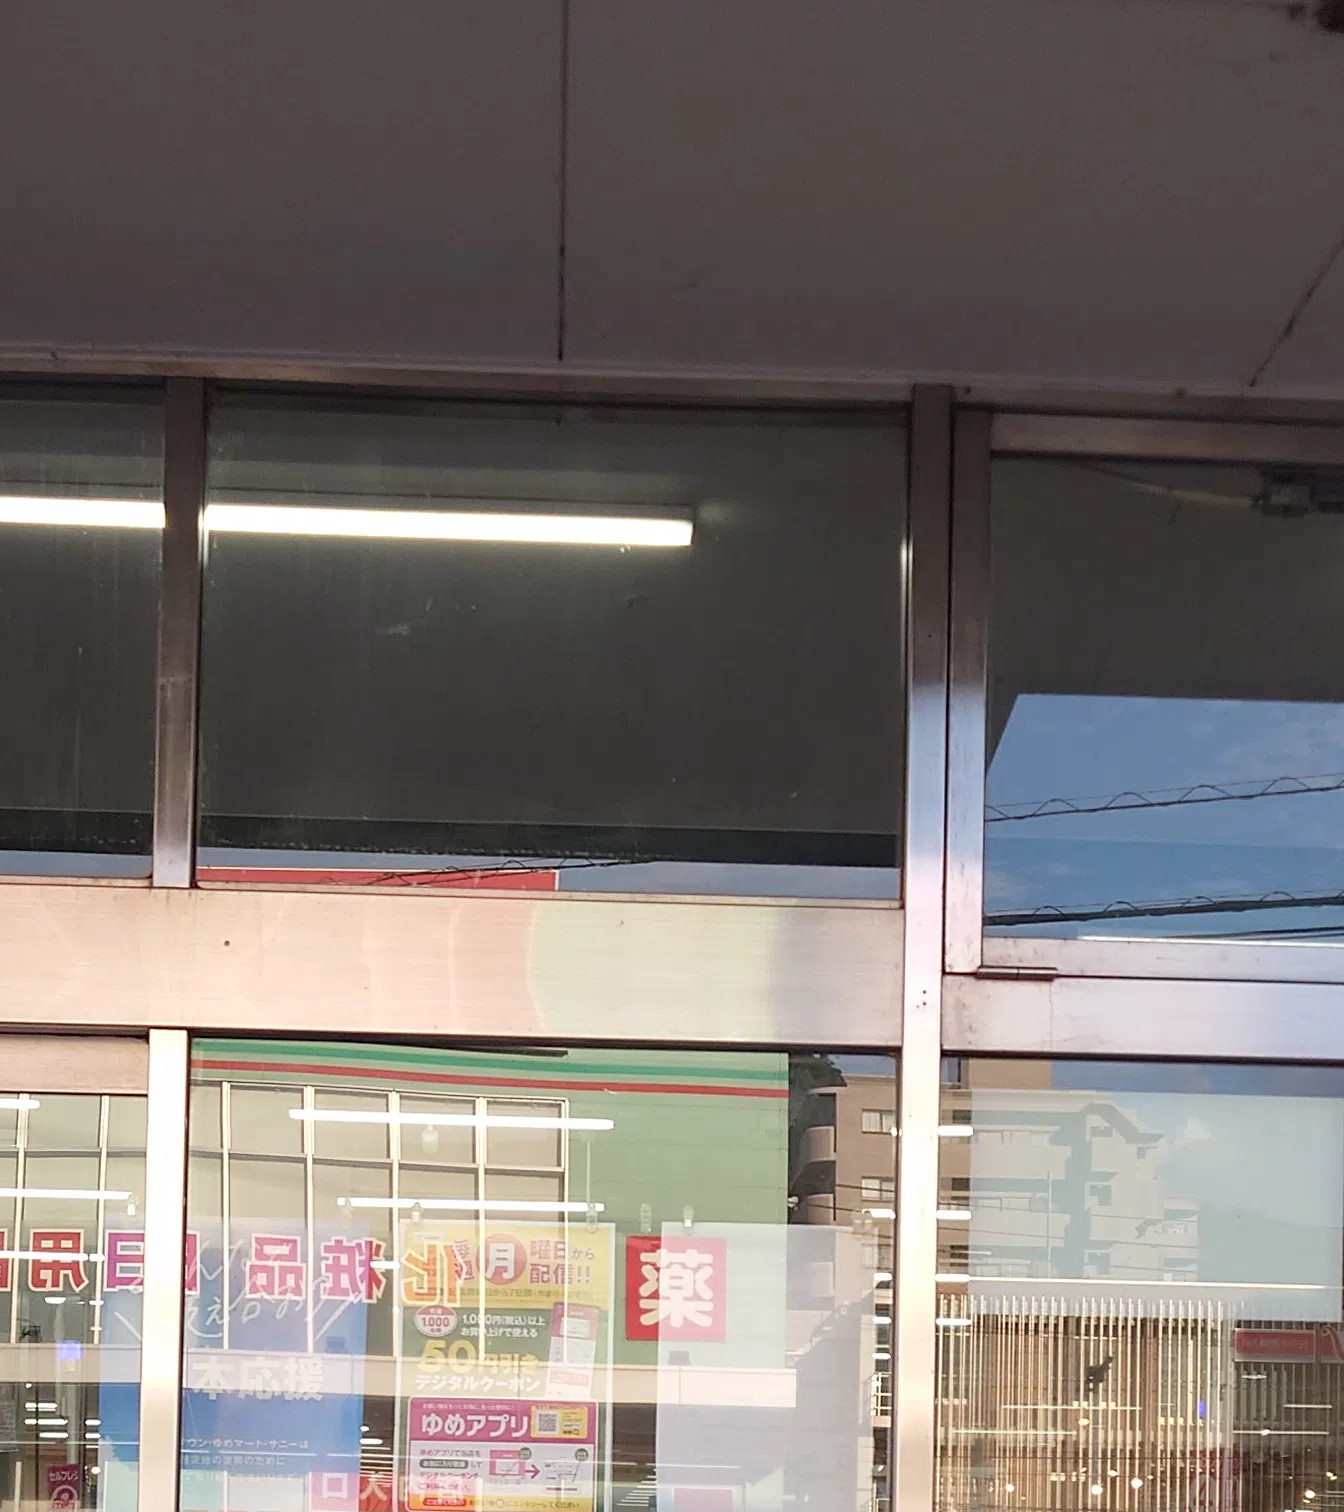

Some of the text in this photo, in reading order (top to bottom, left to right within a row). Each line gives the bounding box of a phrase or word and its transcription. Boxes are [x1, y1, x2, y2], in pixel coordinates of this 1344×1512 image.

[485, 1242, 517, 1280] 月
[415, 1374, 541, 1393] デジタルクーポン
[421, 1412, 528, 1438] ゆめアプリ
